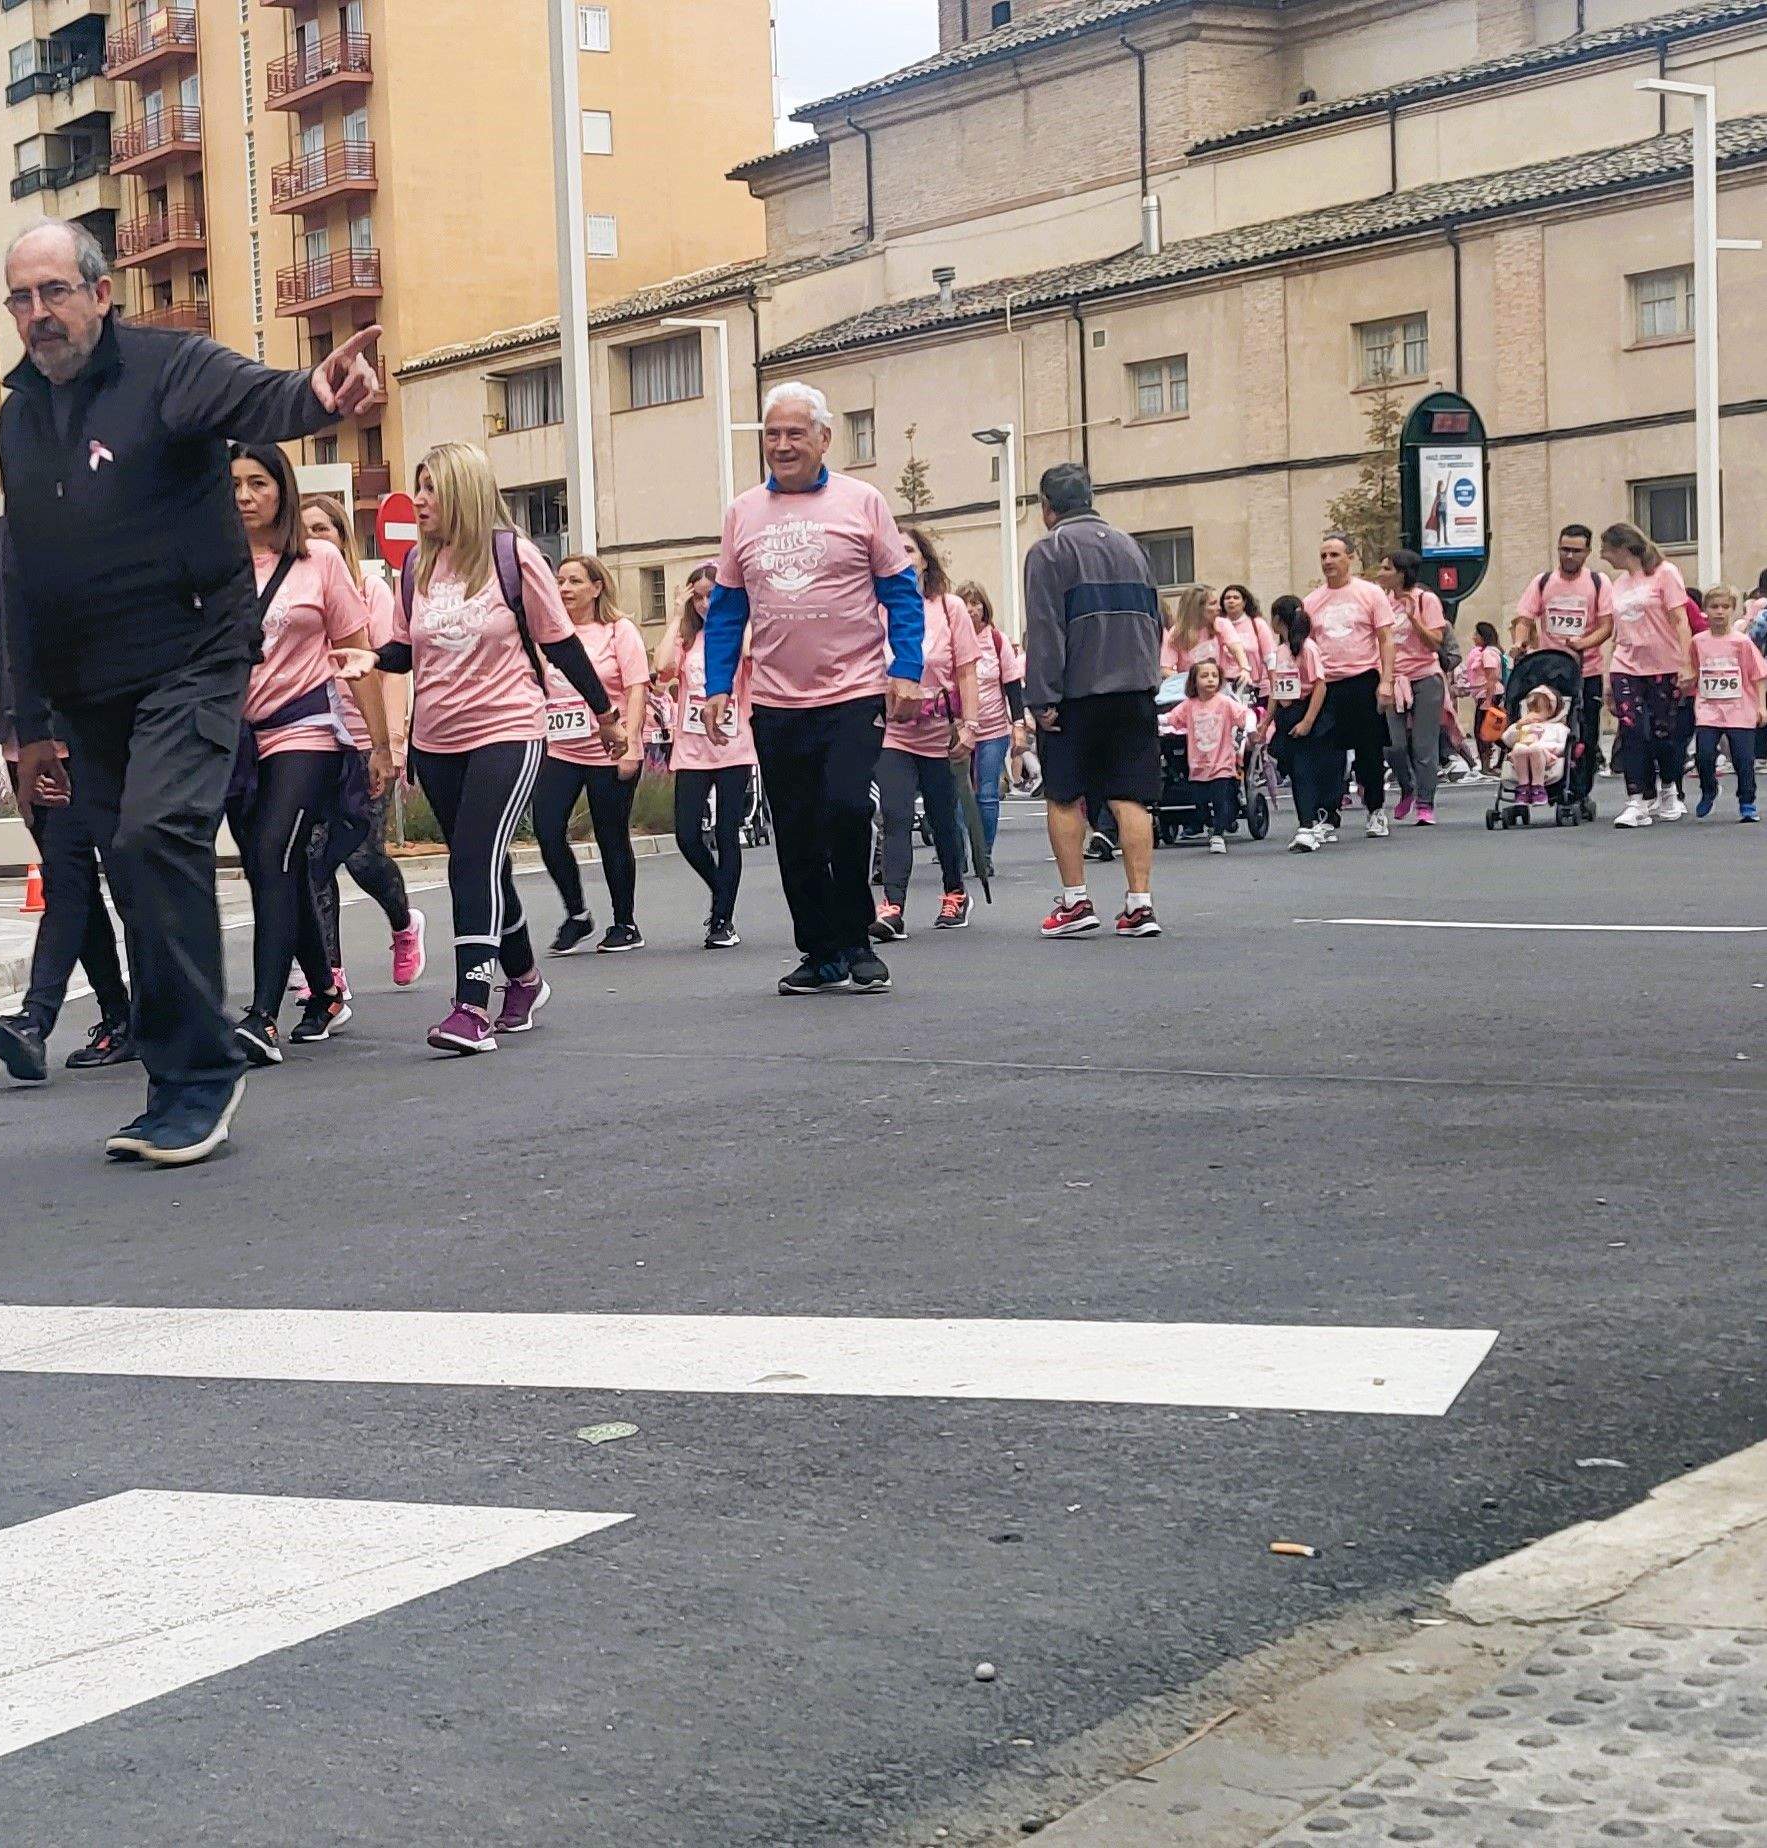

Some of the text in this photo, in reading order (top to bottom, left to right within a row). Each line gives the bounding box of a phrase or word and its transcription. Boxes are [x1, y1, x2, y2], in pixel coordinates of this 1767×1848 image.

[1550, 615, 1583, 628] 1793
[1703, 677, 1739, 691] 1796
[547, 711, 585, 730] 2073
